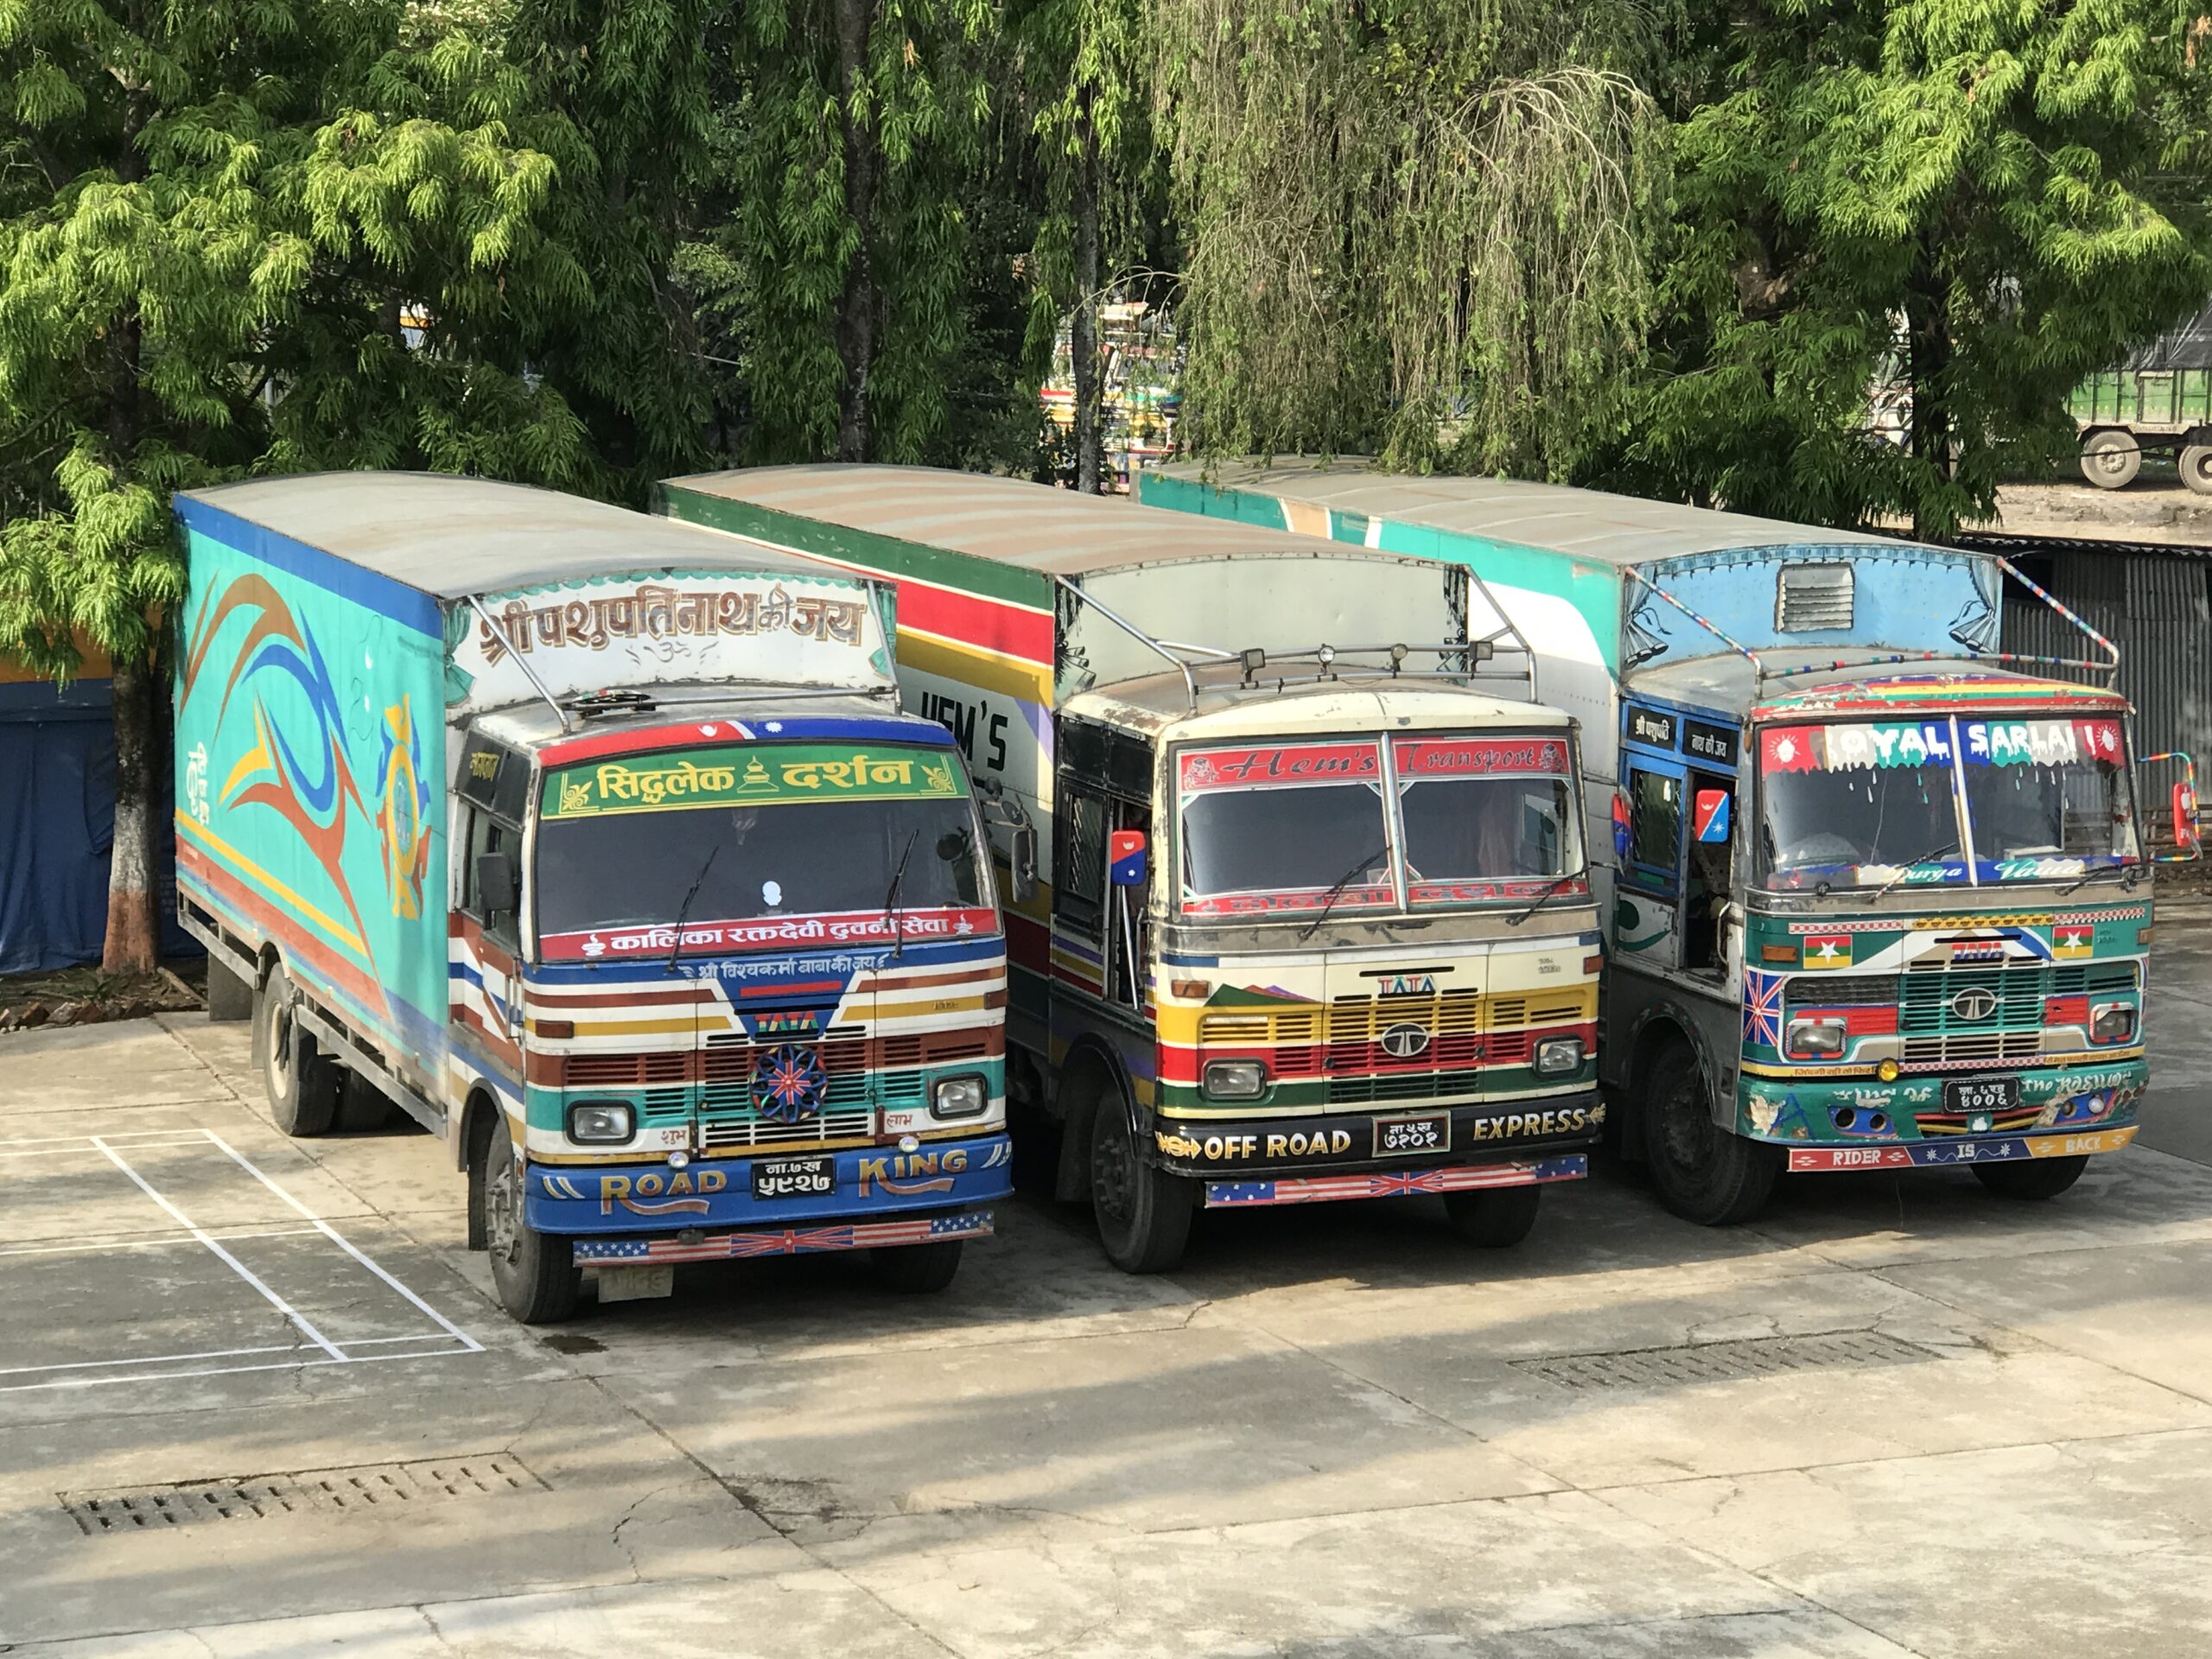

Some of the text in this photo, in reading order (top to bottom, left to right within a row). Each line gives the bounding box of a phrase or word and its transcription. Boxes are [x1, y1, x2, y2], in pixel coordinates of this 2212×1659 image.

[791, 596, 868, 646] जय
[780, 755, 914, 789] दर्शन
[1220, 743, 1535, 779] Hem's Transport
[610, 929, 724, 950] कालिका
[899, 916, 950, 936] सेवा
[1950, 941, 2005, 960] TATA
[699, 963, 719, 979] श्री
[1377, 975, 1436, 993] TATA
[754, 1011, 819, 1032] TATA
[1473, 1109, 1586, 1141] EXPRESS
[1204, 1130, 1351, 1160] OFF ROAD
[1833, 1138, 2101, 1166] RIDER IS BACK
[601, 1149, 969, 1216] ROAD KING
